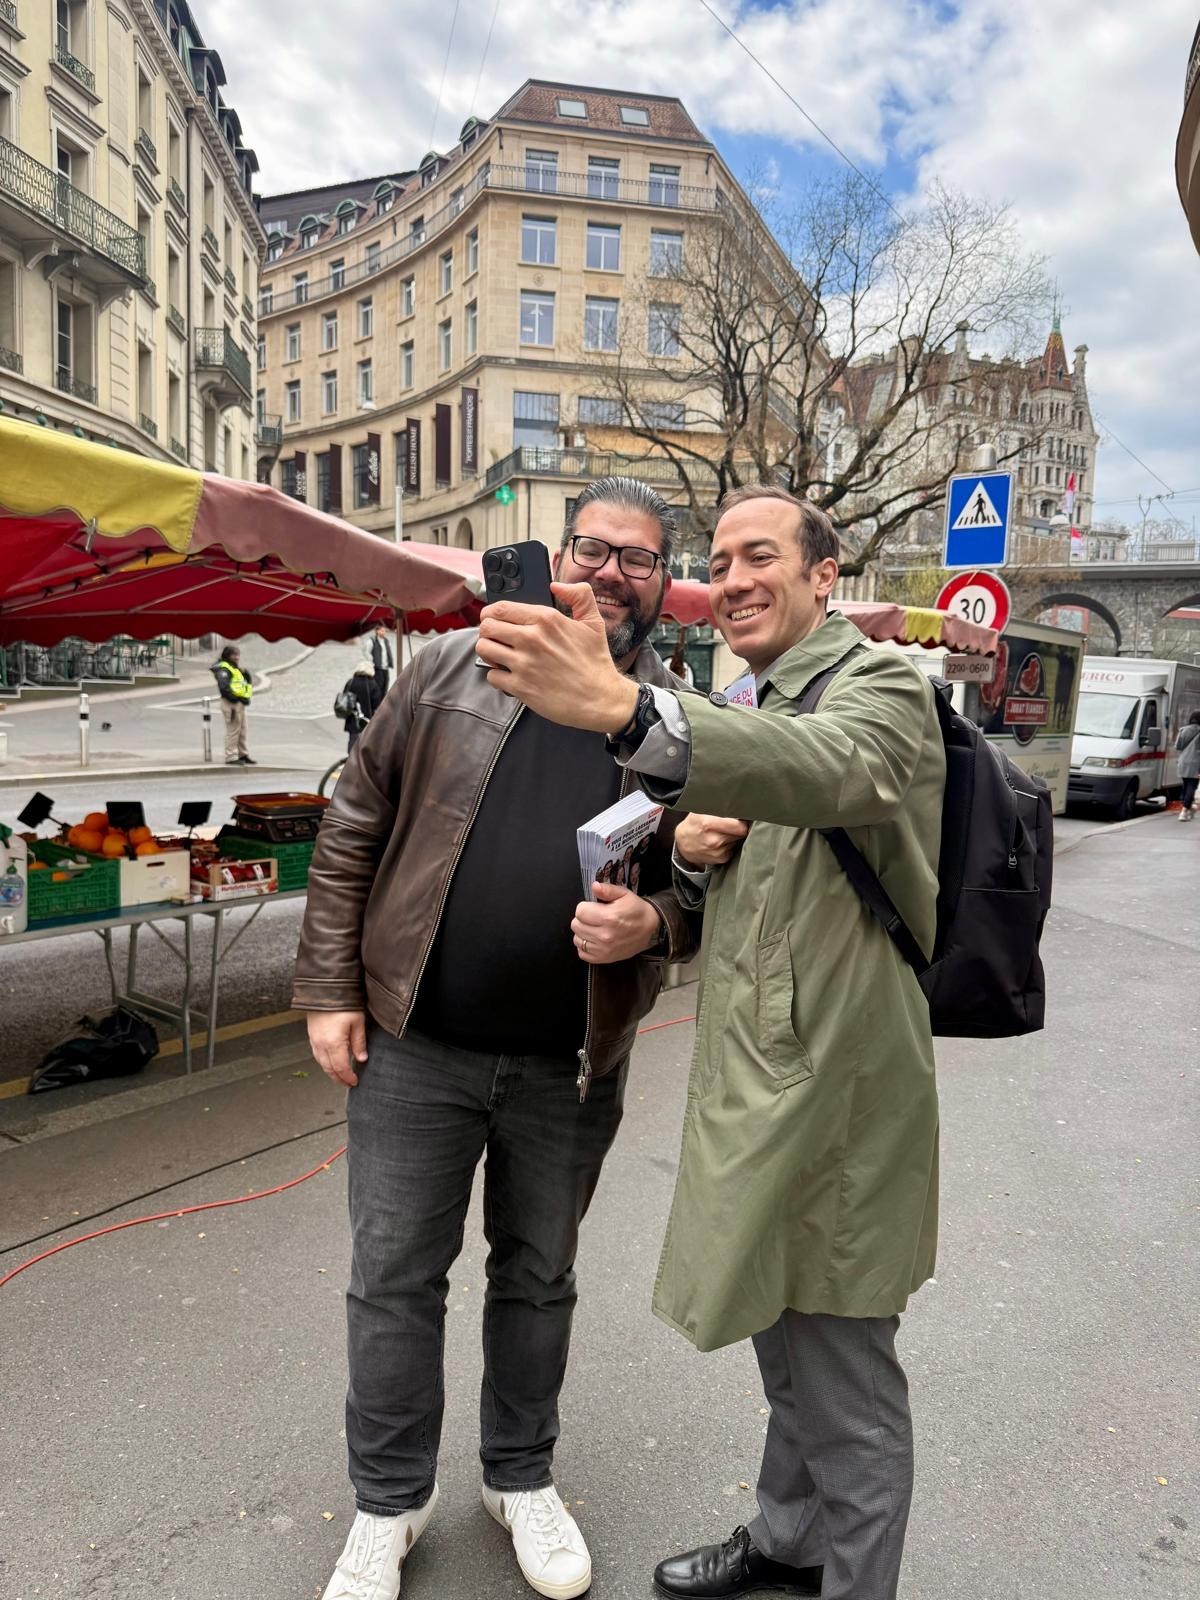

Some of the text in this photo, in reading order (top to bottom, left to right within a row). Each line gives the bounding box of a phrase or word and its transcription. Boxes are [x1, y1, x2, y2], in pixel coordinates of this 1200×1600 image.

[960, 598, 986, 624] 30
[742, 688, 752, 700] DU
[623, 829, 635, 838] POUR
